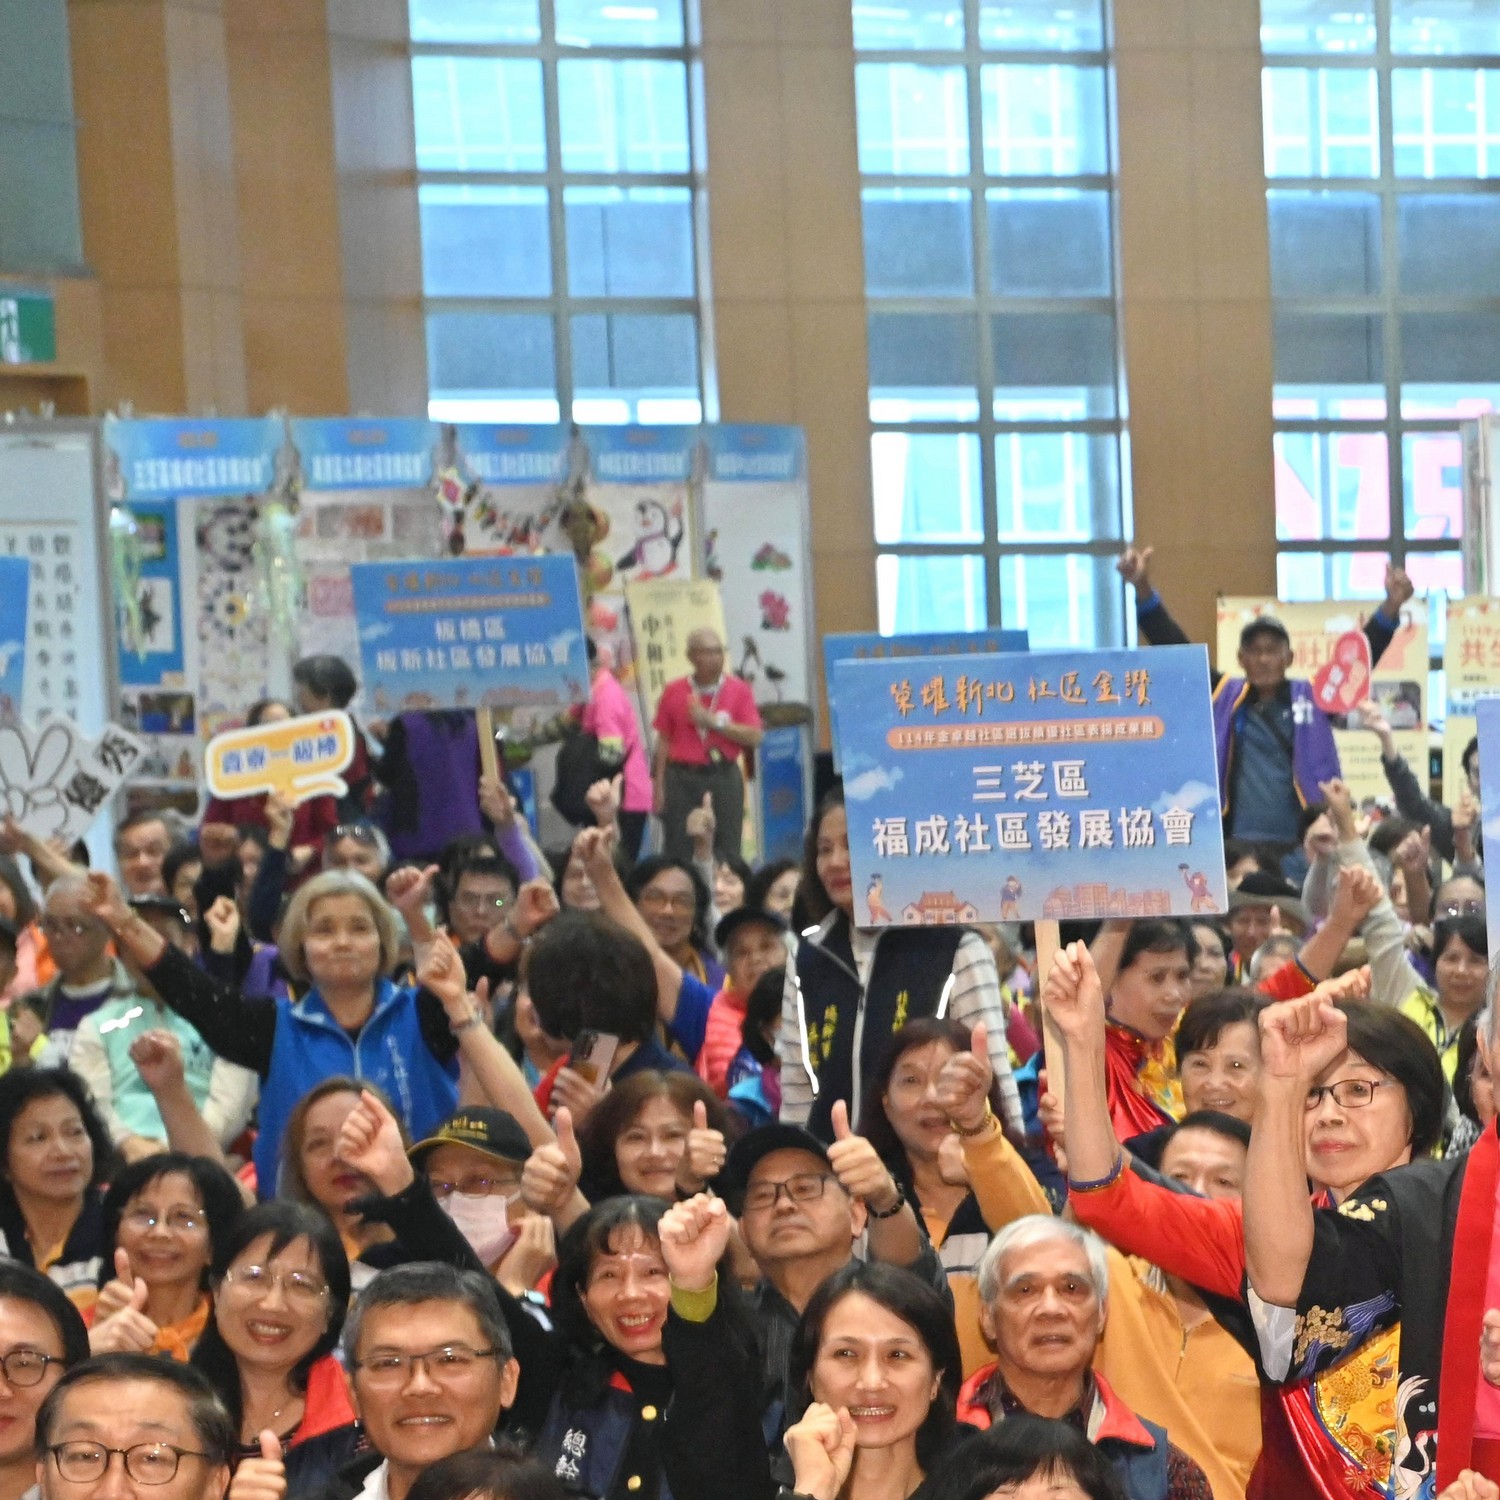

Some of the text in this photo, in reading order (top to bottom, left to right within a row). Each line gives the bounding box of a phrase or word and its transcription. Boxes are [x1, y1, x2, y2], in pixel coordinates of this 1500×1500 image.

[435, 616, 507, 641] 板橋區
[890, 670, 1152, 716] 榮耀新北 社區金讚
[972, 759, 1090, 803] 三芝區
[871, 807, 1195, 858] 福成社區發展協會
